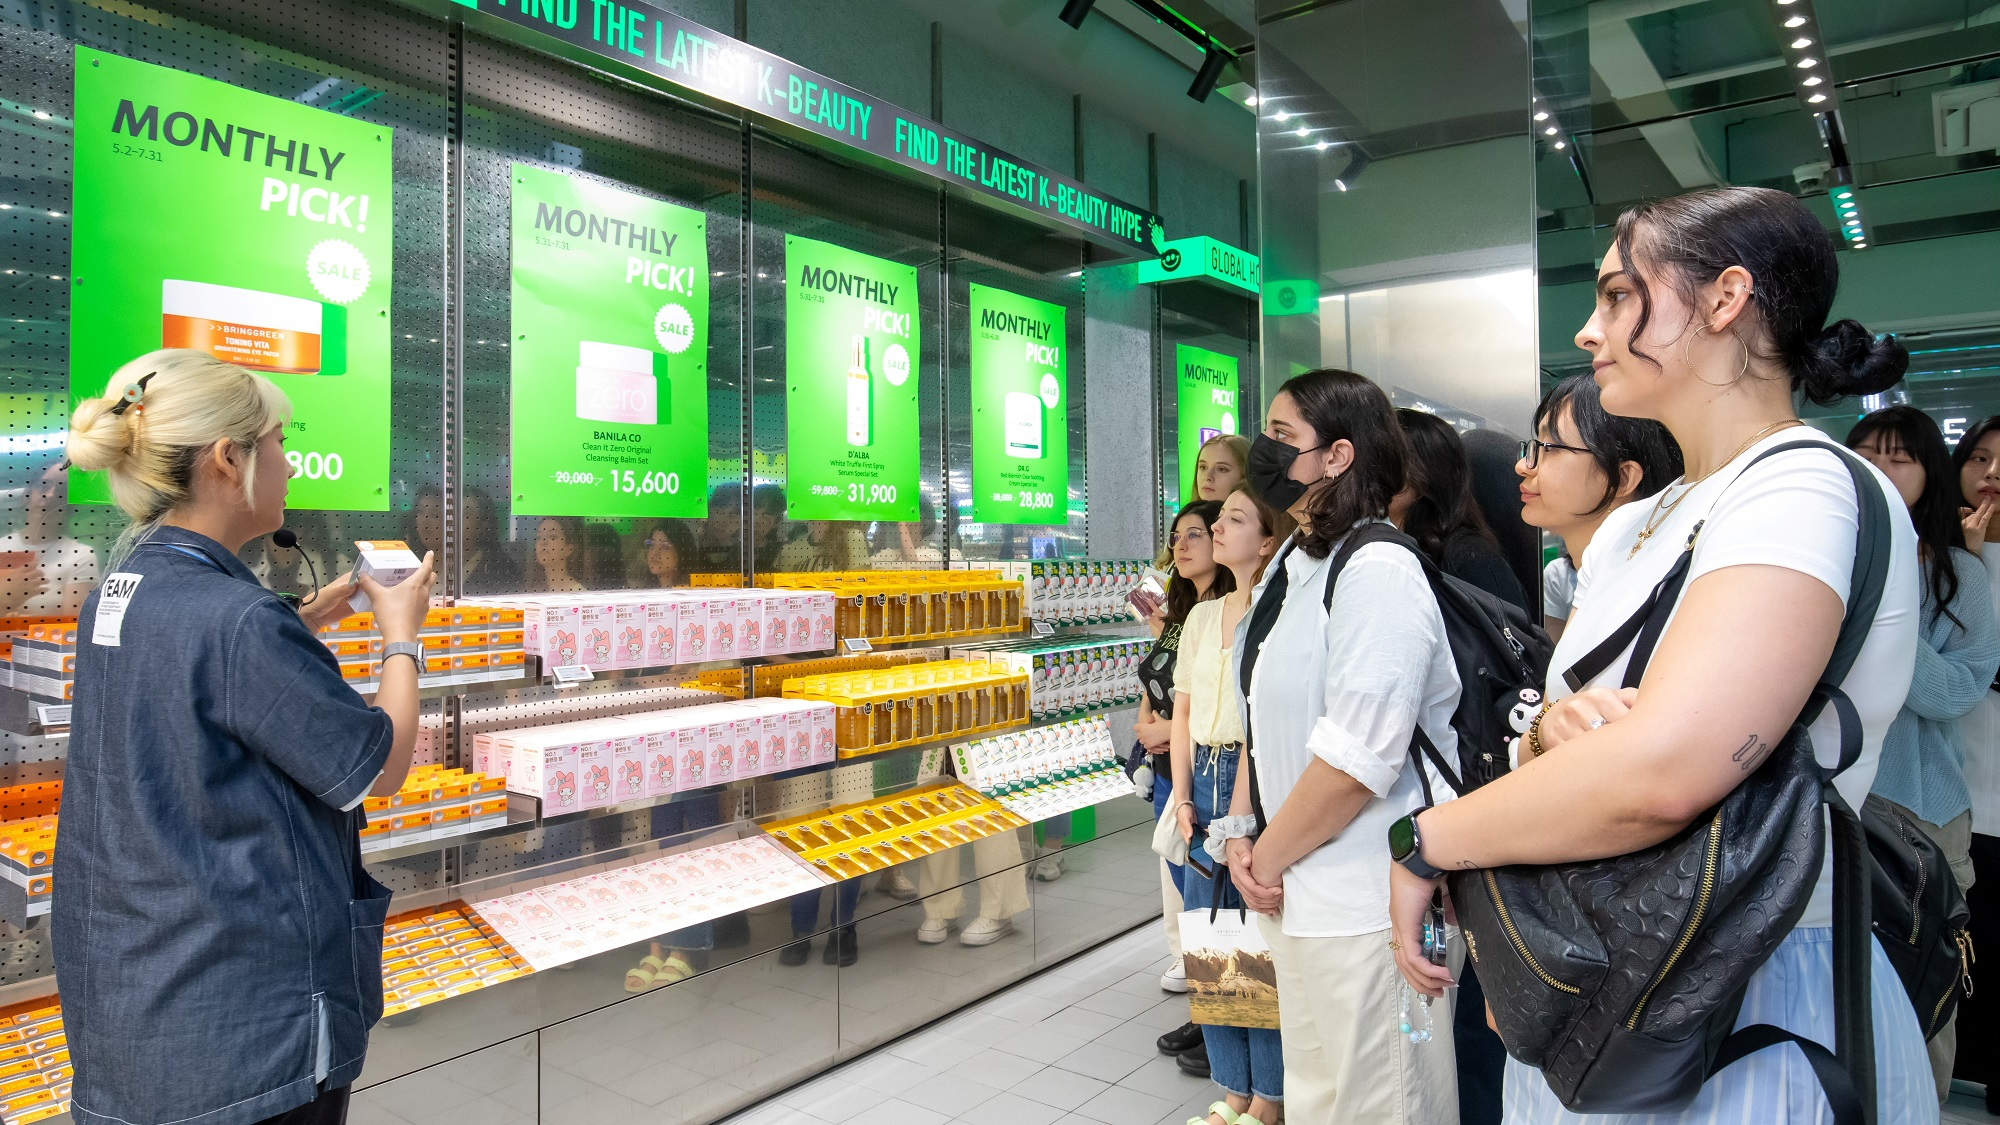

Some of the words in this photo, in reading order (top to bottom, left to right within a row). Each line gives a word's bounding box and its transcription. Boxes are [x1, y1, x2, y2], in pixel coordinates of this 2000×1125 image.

[591, 0, 645, 58] THE
[656, 20, 750, 94] LATEST
[757, 62, 872, 140] K-BEAUTY
[895, 117, 939, 165] FIND
[943, 136, 976, 181] THE
[981, 152, 1035, 202] LATEST
[1039, 176, 1108, 229] K-BEAUTY
[1111, 204, 1142, 242] HYPE
[111, 98, 346, 181] MONTHLY
[260, 176, 369, 232] PICK!
[534, 202, 678, 257] MONTHLY
[317, 261, 362, 281] SALE
[1211, 246, 1246, 281] GLOBAL
[625, 256, 694, 297] PICK!
[800, 264, 898, 306] MONTHLY
[660, 321, 689, 336] SALE
[864, 306, 910, 339] PICK!
[980, 308, 1051, 341] MONTHLY
[225, 336, 253, 347] TONING
[254, 339, 270, 350] VITA
[887, 360, 906, 371] SALE
[1025, 341, 1059, 368] PICK!
[1184, 363, 1228, 386] MONTHLY
[589, 386, 647, 413] zero
[1212, 388, 1234, 408] PICK!
[290, 419, 306, 431] ing
[593, 431, 627, 441] BANILA
[629, 434, 641, 442] CO
[582, 442, 602, 451] Clean
[603, 443, 609, 452] It
[610, 444, 625, 453] Zero
[626, 445, 651, 455] Original
[585, 453, 619, 464] Cleansing
[620, 455, 637, 464] Balm
[638, 456, 649, 464] Set
[848, 450, 869, 459] D'ALBA
[285, 450, 343, 480] 800
[854, 470, 870, 478] Special
[873, 462, 885, 470] Spray
[555, 471, 593, 485] 20,000
[610, 469, 679, 497] 15,600
[811, 485, 838, 496] 59,800
[847, 483, 897, 505] 31,900
[1019, 490, 1053, 510] 28,800
[104, 579, 136, 598] TEAM
